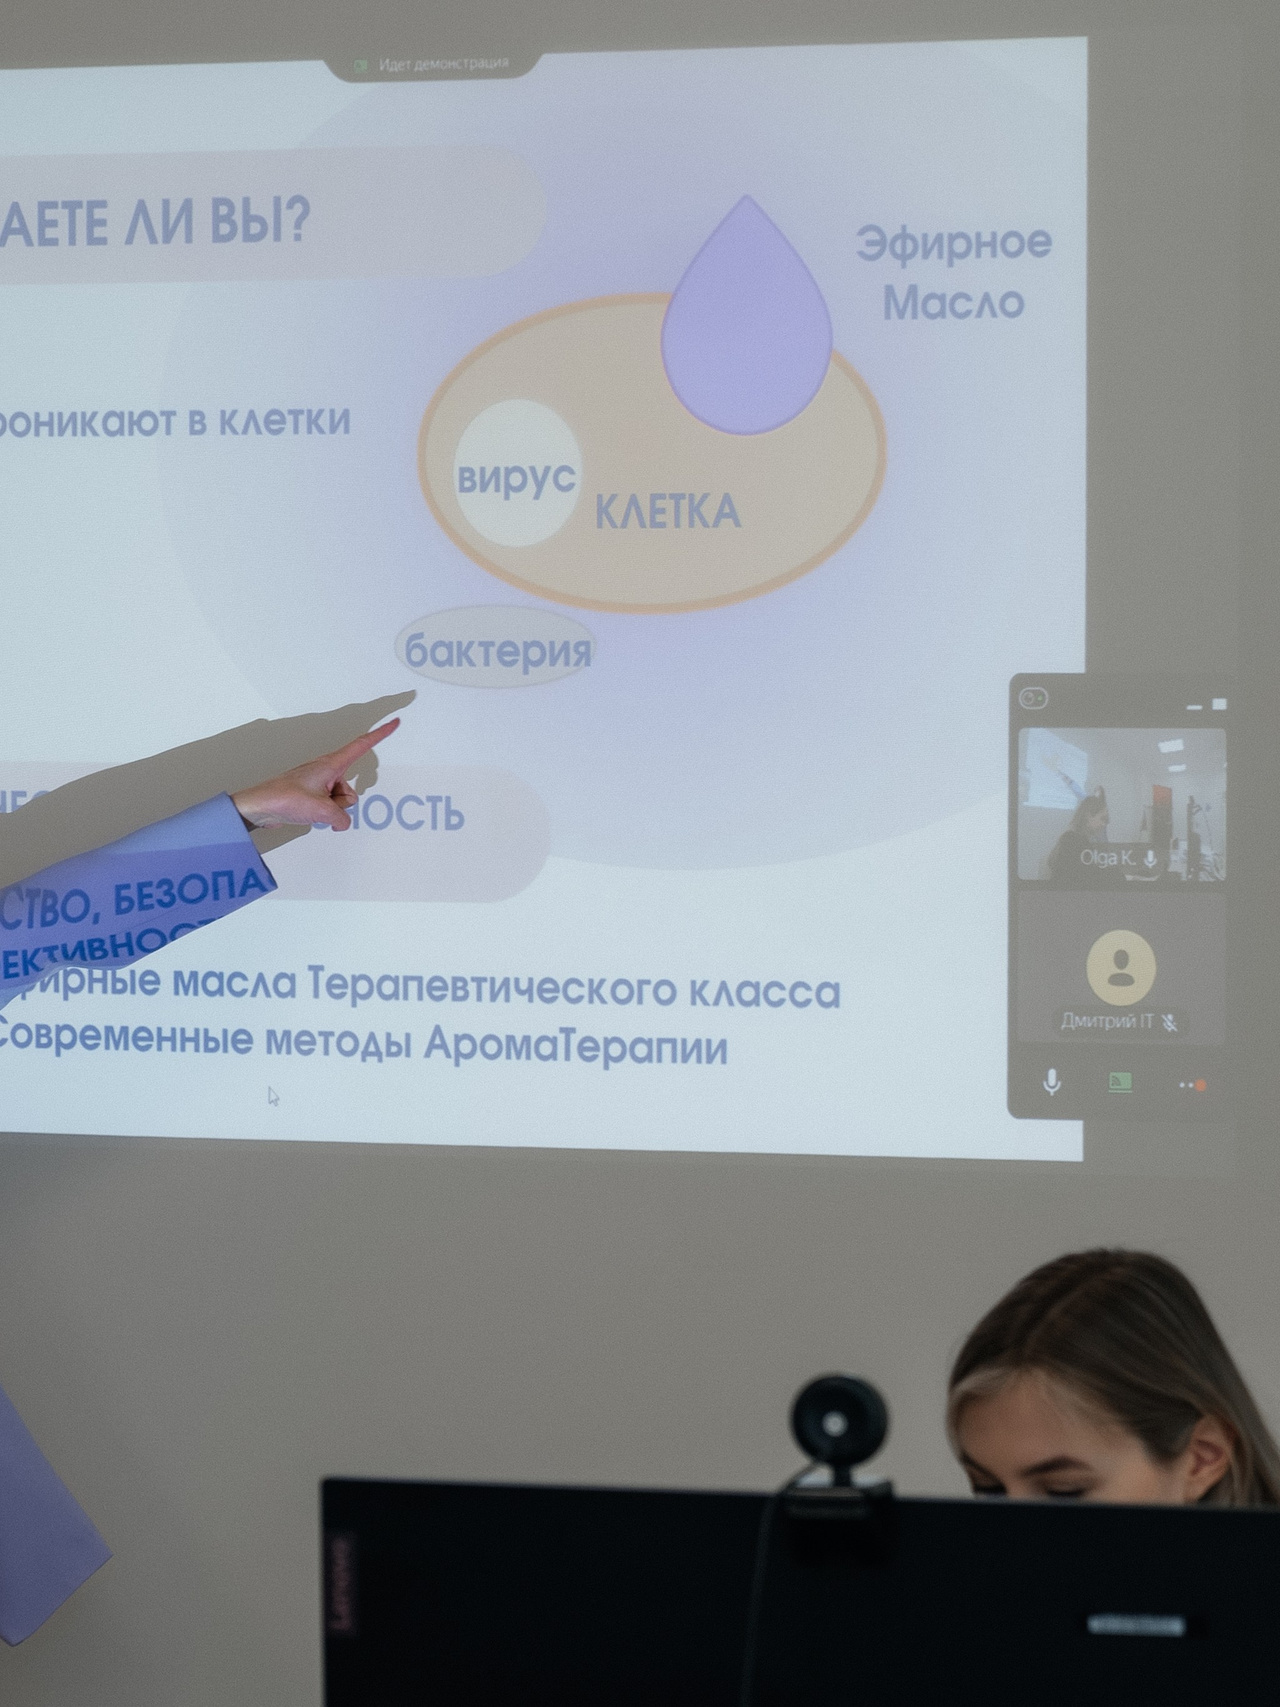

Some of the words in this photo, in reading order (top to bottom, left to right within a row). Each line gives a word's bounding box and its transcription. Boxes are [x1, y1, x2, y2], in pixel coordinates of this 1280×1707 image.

[379, 58, 411, 73] Идет
[414, 57, 509, 72] демонстрация
[124, 198, 194, 246] ЛИ
[211, 195, 312, 243] ВЫ?
[856, 224, 1053, 269] Эфирное
[884, 284, 1025, 320] Масло
[189, 409, 208, 436] в
[220, 408, 351, 436] клетки
[458, 464, 577, 500] вирус
[596, 493, 741, 529] КЛЕТКА
[405, 632, 592, 675] бактерия
[1080, 849, 1118, 869] Olga
[173, 969, 296, 999] масла
[308, 965, 678, 1008] Терапевтического
[690, 977, 841, 1009] класса
[1061, 1012, 1136, 1031] Дмитрий
[266, 1026, 412, 1064] методы
[424, 1024, 728, 1070] АромаТерапии
